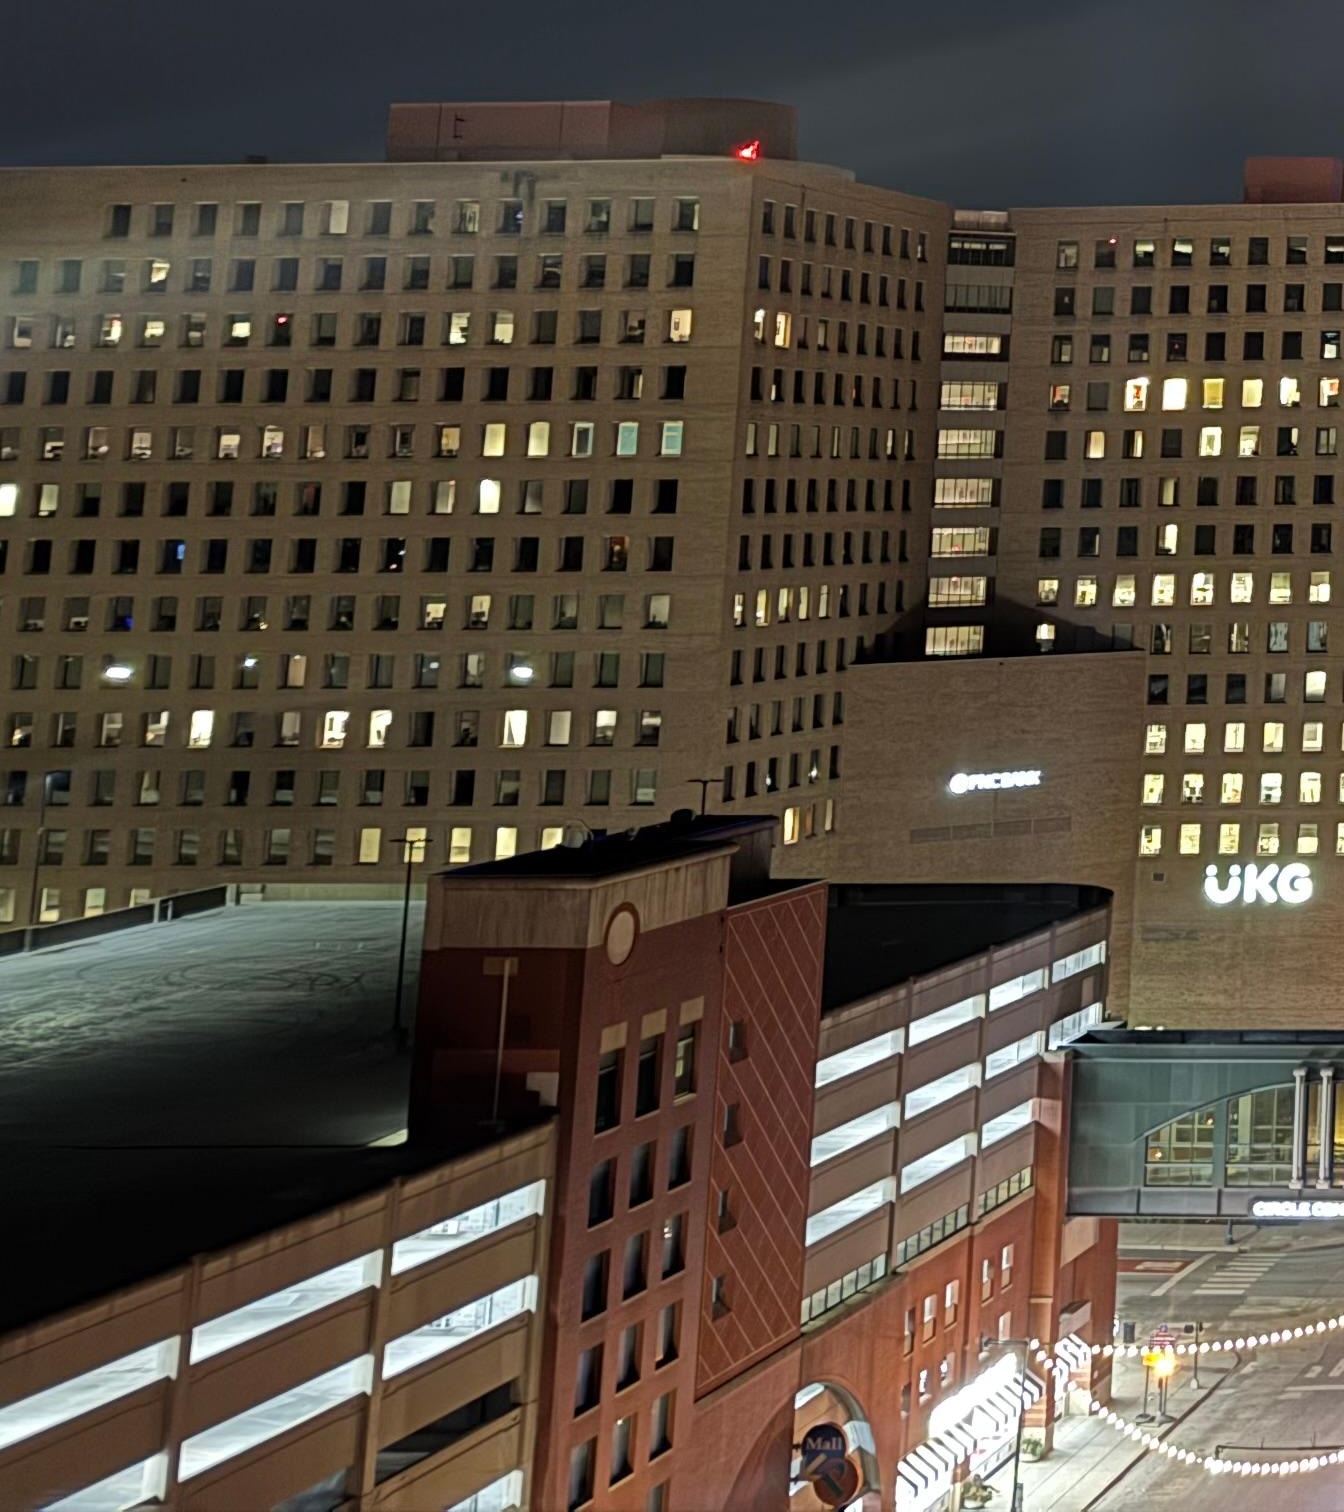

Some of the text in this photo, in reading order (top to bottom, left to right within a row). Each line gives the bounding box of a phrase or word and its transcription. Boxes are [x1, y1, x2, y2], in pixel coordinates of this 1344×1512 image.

[1204, 862, 1314, 904] UKG
[1253, 1201, 1311, 1217] CIRCLE
[806, 1436, 843, 1450] Mall
